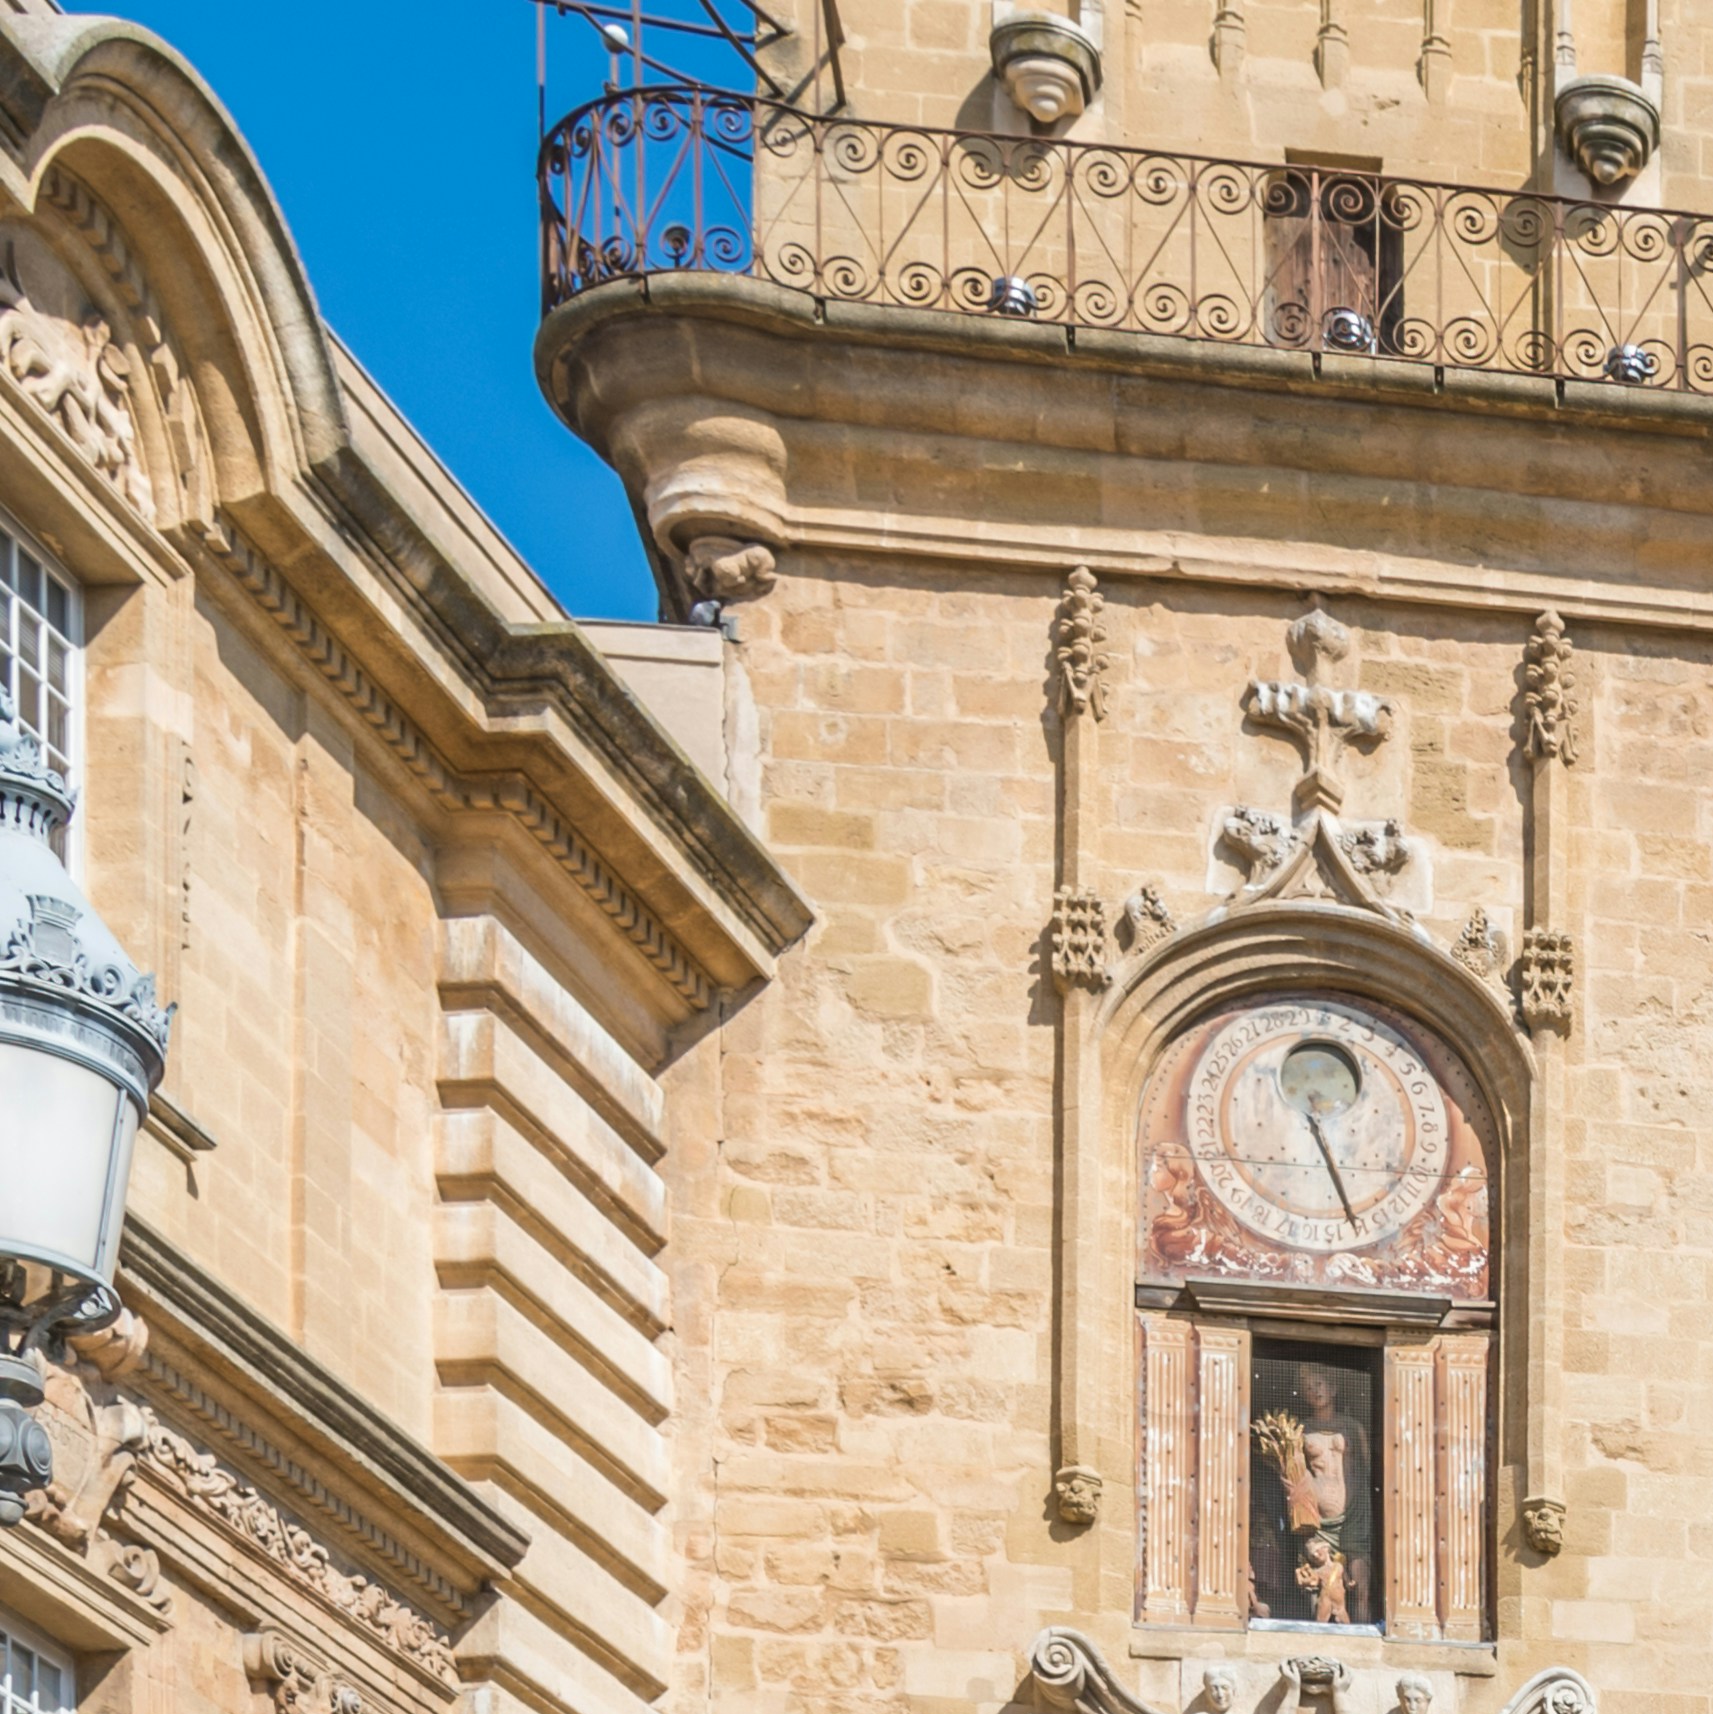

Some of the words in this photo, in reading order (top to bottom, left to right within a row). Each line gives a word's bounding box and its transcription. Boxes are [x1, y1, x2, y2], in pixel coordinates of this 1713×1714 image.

[1399, 1062, 1418, 1076] 5
[1411, 1081, 1427, 1096] 6
[1422, 1121, 1439, 1134] 8
[1420, 1142, 1438, 1155] 9
